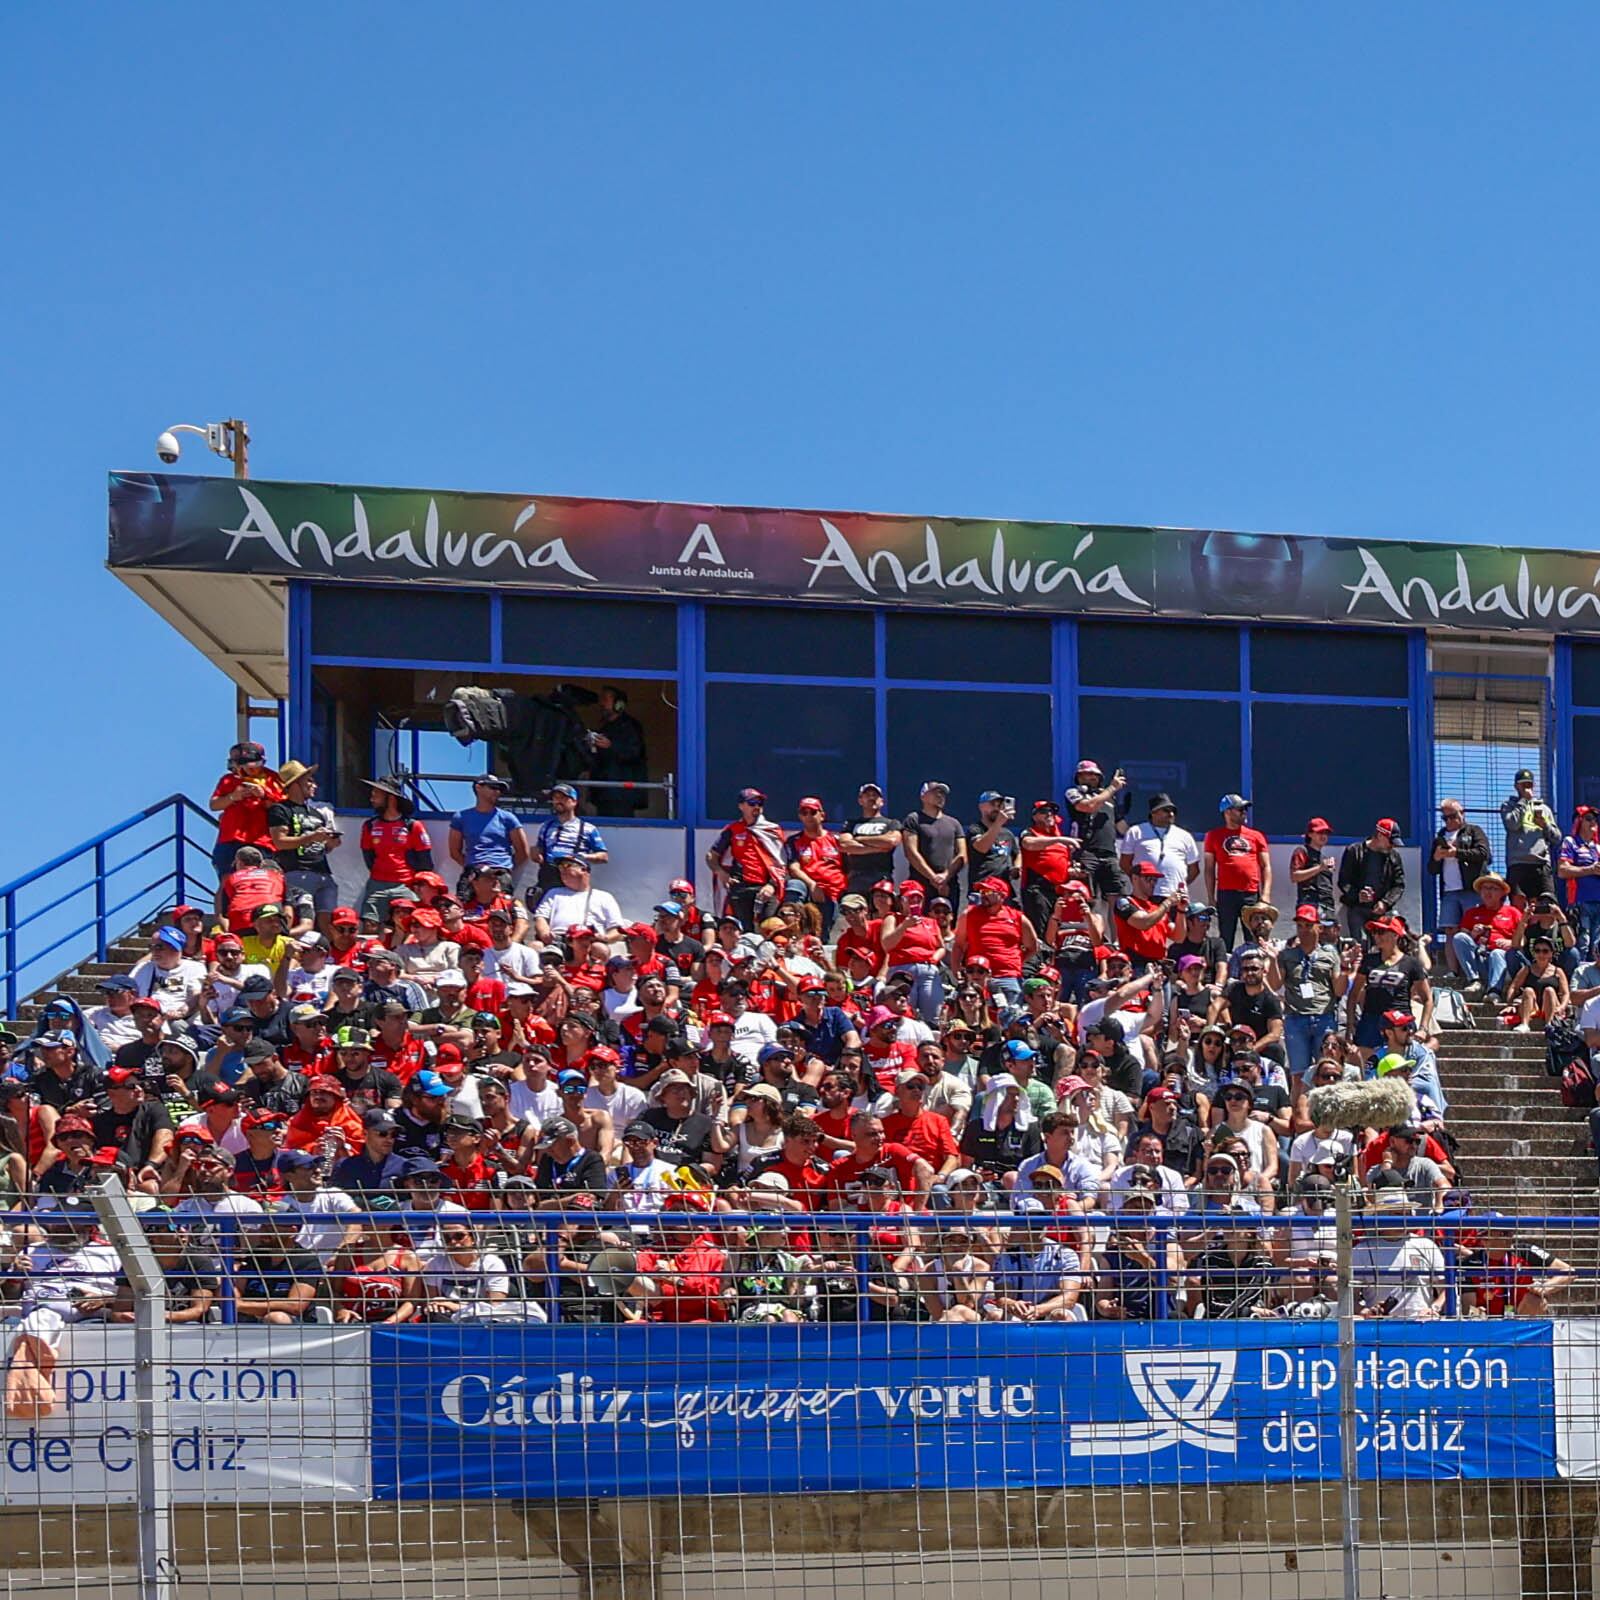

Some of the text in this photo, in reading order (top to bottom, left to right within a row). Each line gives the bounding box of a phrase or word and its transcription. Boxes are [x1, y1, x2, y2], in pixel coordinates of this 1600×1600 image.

[219, 486, 599, 582] Andalucía
[649, 565, 754, 580] Junta de Andalucía
[802, 517, 1153, 607] Andalucía
[441, 1372, 631, 1426] Cádiz
[871, 1374, 1034, 1419] verte
[7, 1425, 247, 1473] de Cdiz
[1263, 1411, 1317, 1452] de
